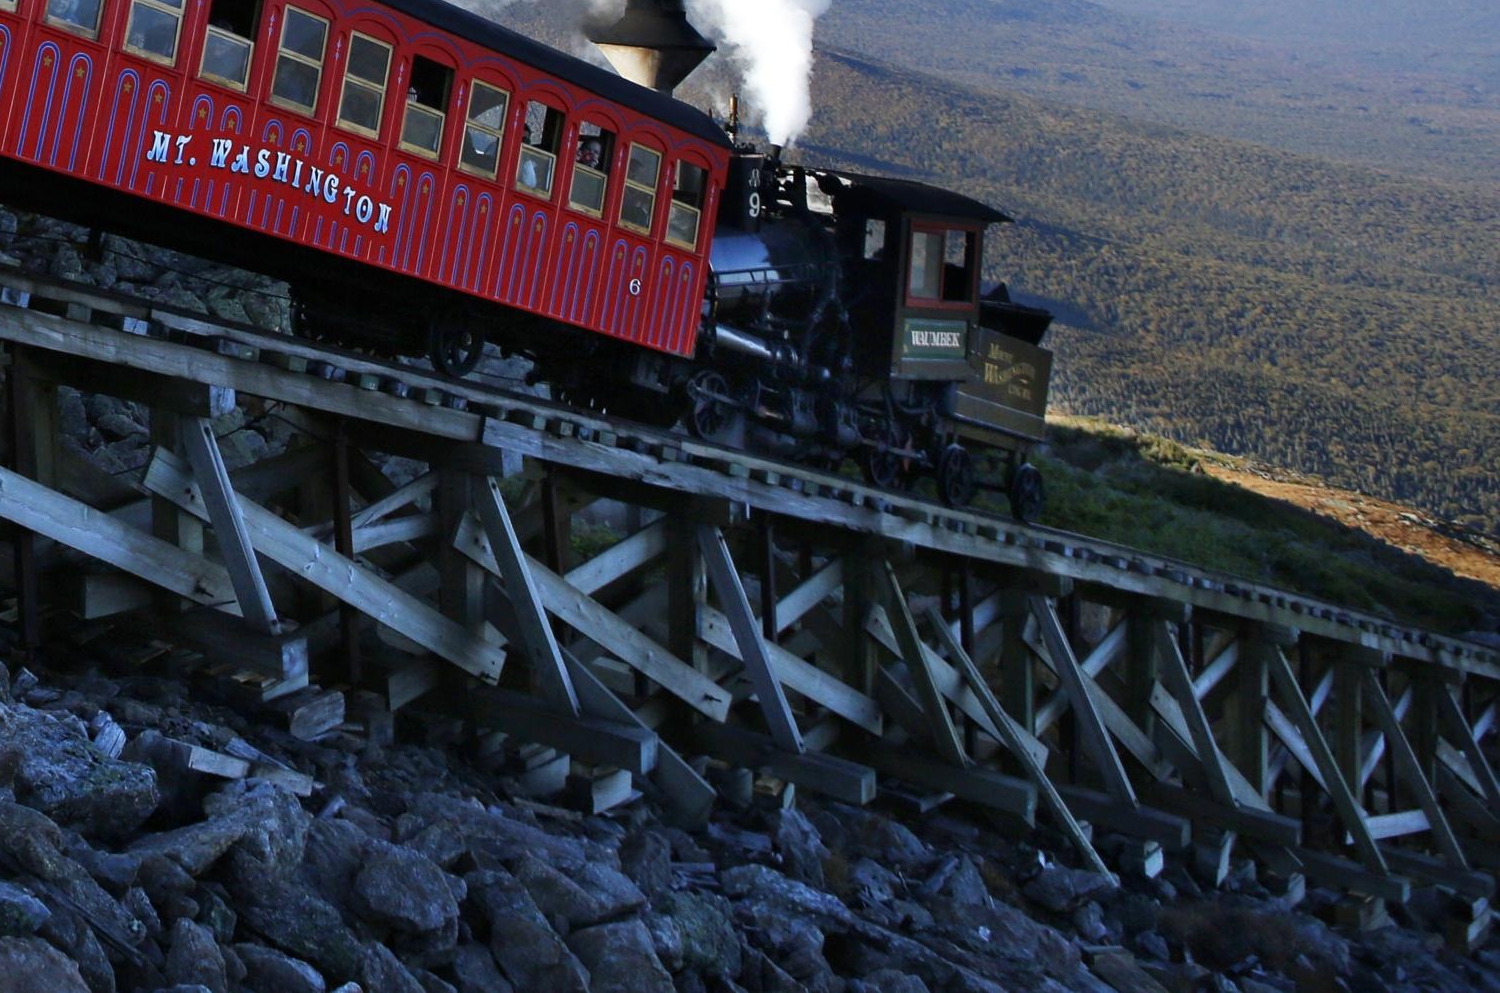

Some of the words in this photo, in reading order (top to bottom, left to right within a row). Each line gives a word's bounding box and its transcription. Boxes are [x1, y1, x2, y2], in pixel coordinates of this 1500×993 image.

[146, 129, 196, 166] MT.
[210, 138, 392, 234] WASHINGTON
[749, 192, 760, 217] 9
[629, 278, 641, 295] 6
[911, 330, 961, 348] WAUMBEK
